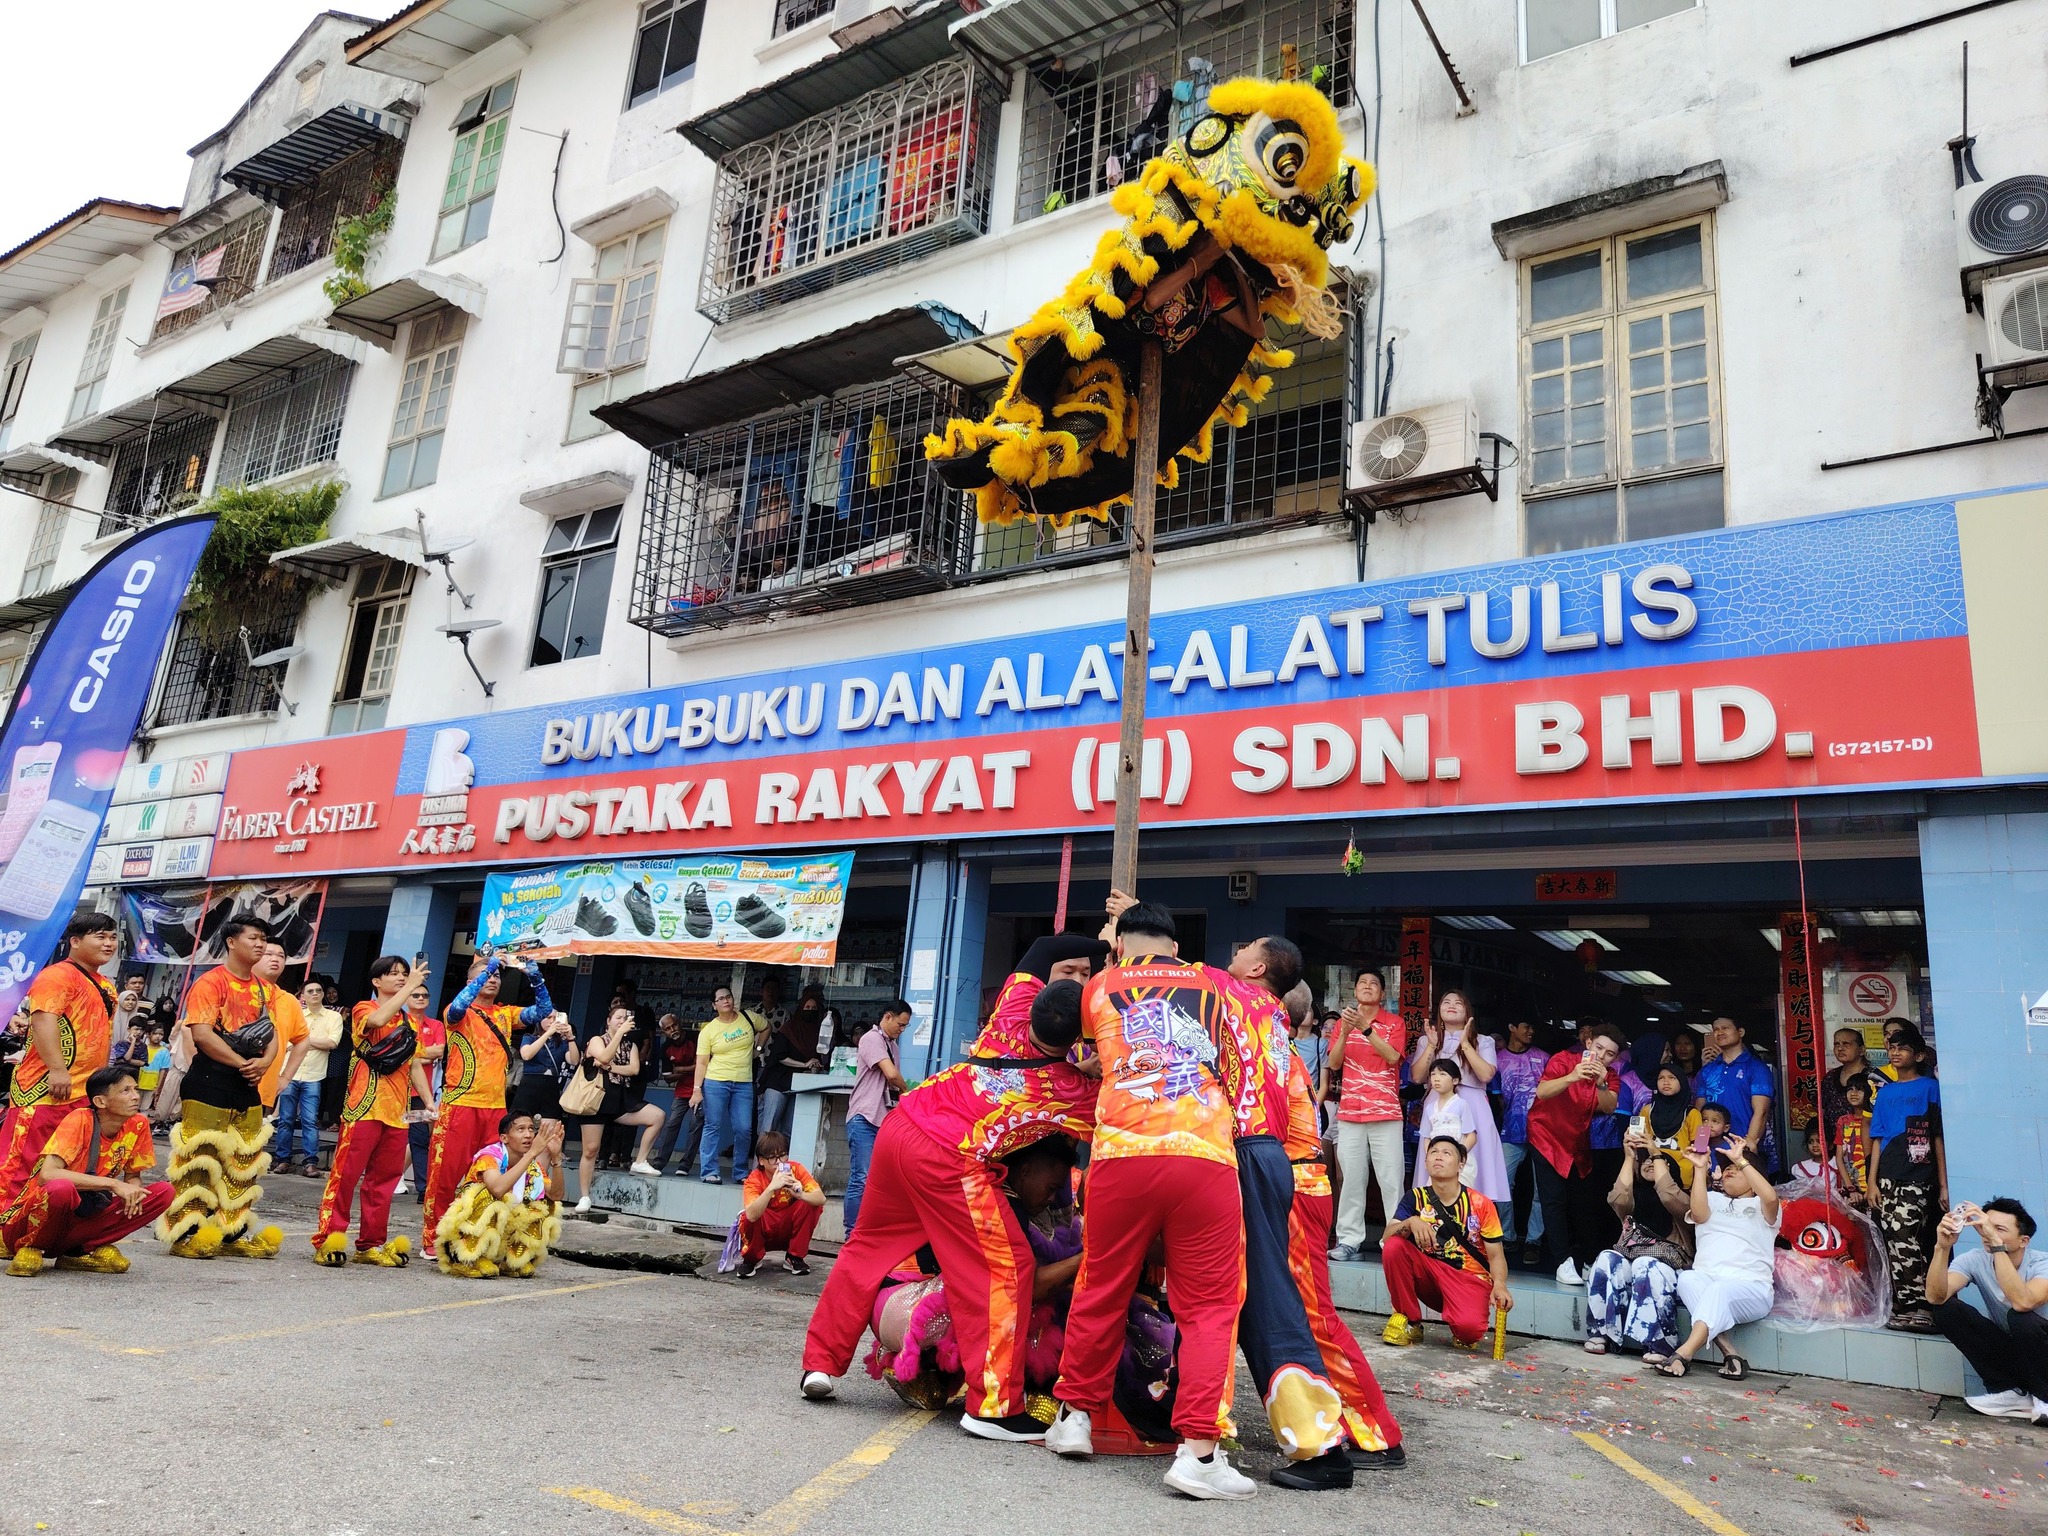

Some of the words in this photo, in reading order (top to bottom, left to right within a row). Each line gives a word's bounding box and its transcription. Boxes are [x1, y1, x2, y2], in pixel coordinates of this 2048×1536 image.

[70, 559, 157, 713] CASIO
[540, 682, 826, 766] BUKU-BUKU
[836, 664, 966, 732] DAN
[1408, 564, 1698, 666] TULIS
[494, 778, 732, 844] PUSTAKA
[755, 749, 1032, 825] RAKYAT
[1231, 713, 1462, 795] SDN.
[1515, 685, 1815, 775] BHD.
[1828, 735, 1934, 758] (372157-D)
[218, 798, 379, 841] FABER-CASTELL
[125, 847, 153, 859] OXFORD
[180, 844, 200, 860] ILMU
[124, 862, 149, 873] FAJAR
[177, 859, 197, 873] BAKTI
[640, 859, 674, 870] Selesa!
[701, 865, 735, 876] Getah!
[762, 868, 794, 878] Besar!
[801, 945, 830, 961] pallas
